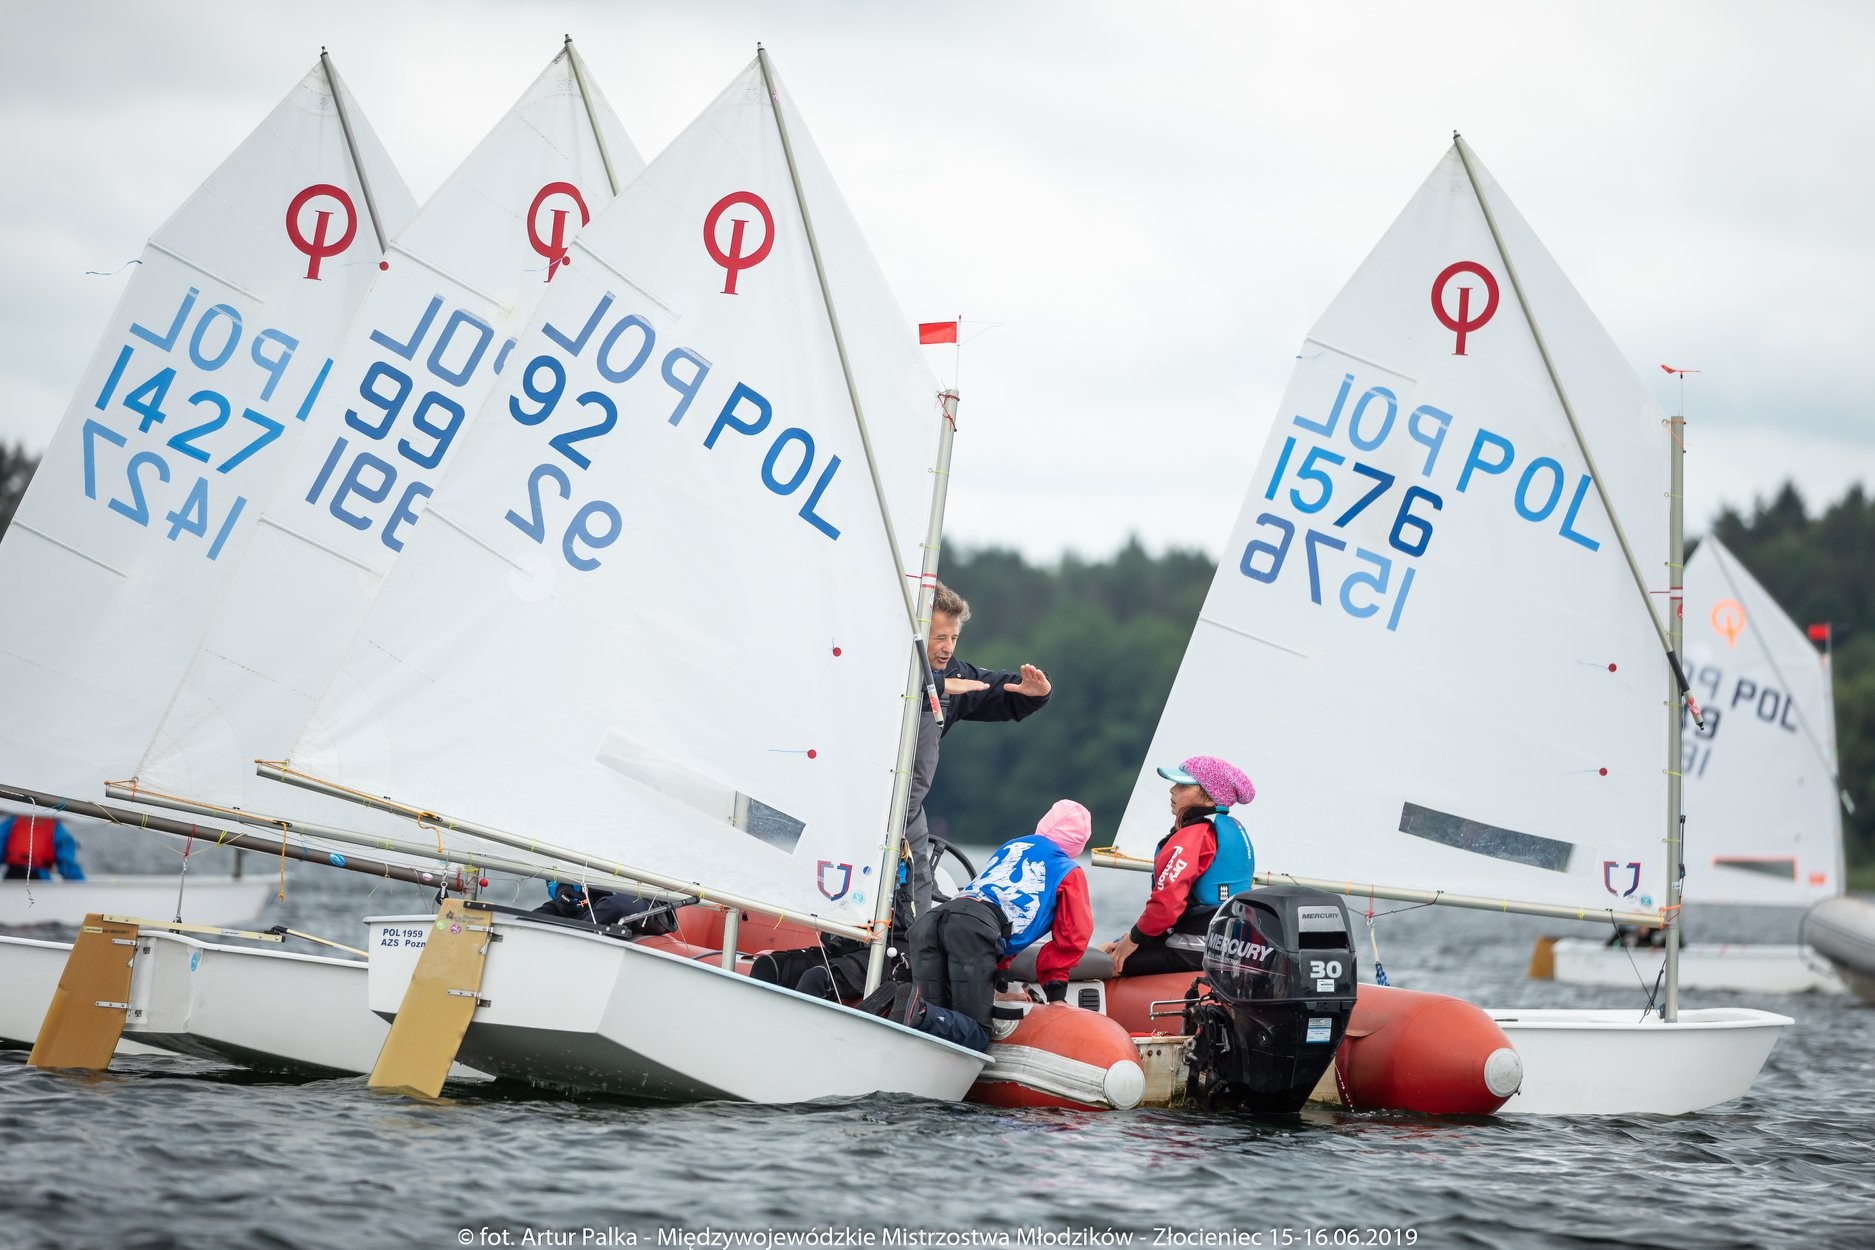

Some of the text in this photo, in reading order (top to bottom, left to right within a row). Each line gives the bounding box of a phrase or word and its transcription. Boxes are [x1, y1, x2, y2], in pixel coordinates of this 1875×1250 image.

[95, 344, 286, 475] 1427
[508, 355, 619, 471] 92
[702, 381, 842, 541] POL
[1455, 427, 1601, 553] POL
[1264, 435, 1444, 558] 1576
[1730, 677, 1798, 735] POL
[380, 938, 399, 947] AZS
[382, 928, 423, 938] POL 1959
[1301, 912, 1339, 920] MERCURY
[1207, 932, 1275, 962] MERCURY
[1310, 960, 1343, 979] 30
